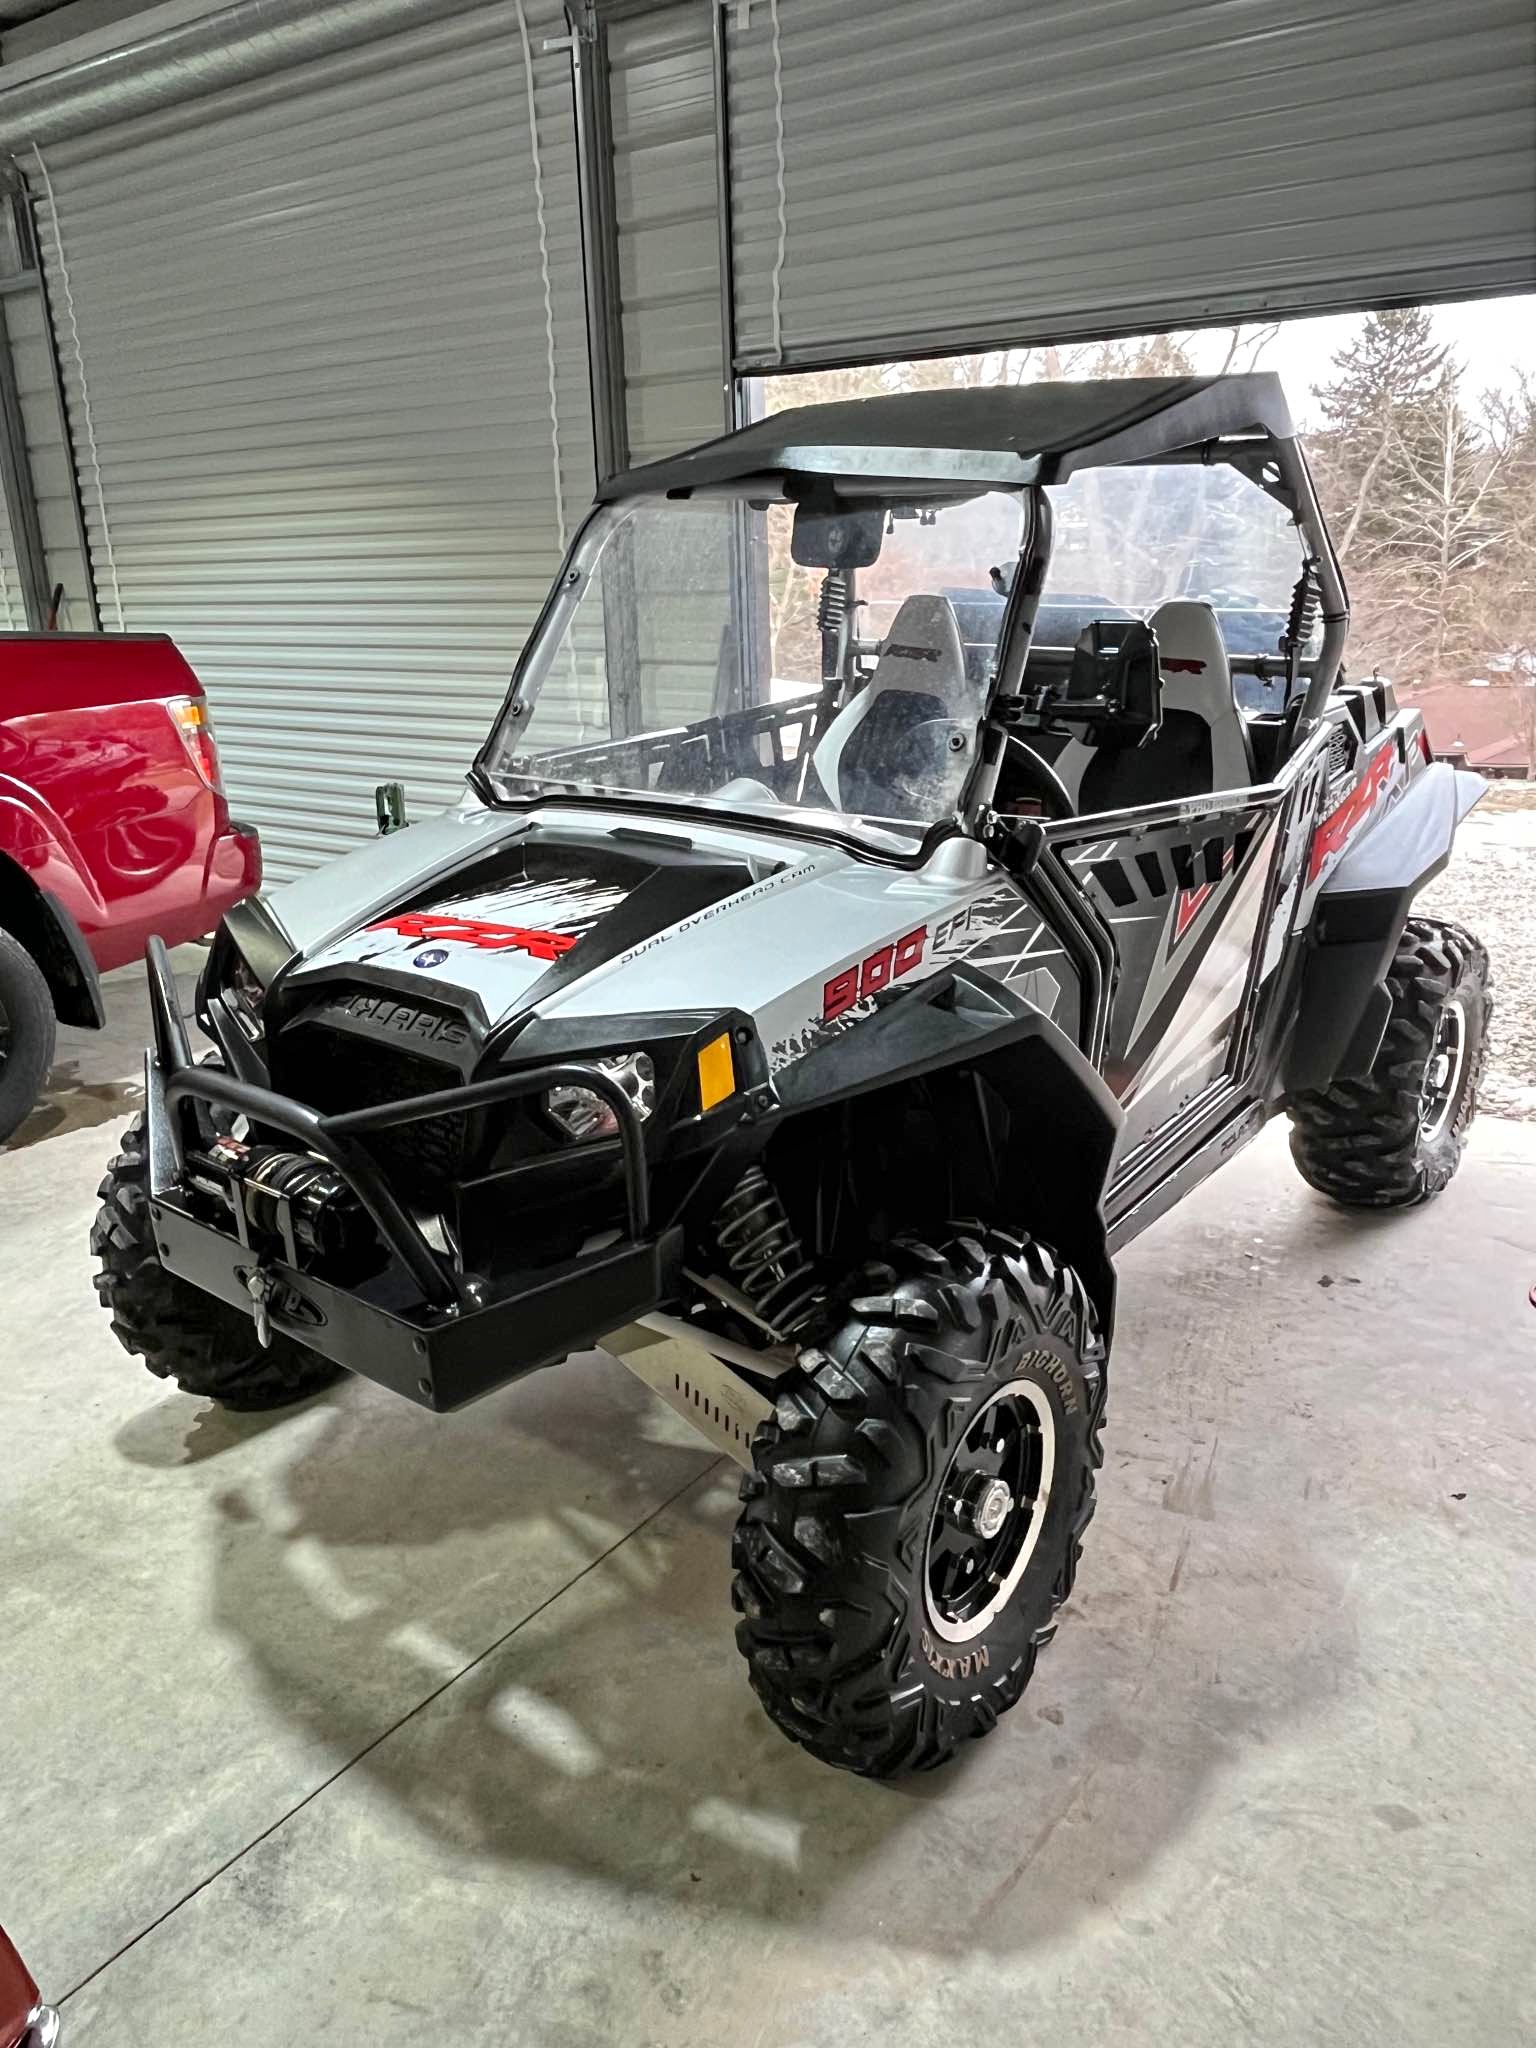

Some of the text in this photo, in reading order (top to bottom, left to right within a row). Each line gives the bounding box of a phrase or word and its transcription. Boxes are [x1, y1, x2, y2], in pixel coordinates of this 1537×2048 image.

[364, 912, 578, 961] RZR
[621, 863, 816, 965] DUAL OVERHEAD CAM
[823, 905, 972, 1023] 900 EFI
[334, 994, 469, 1046] OLARIS
[1013, 1349, 1079, 1416] BIGHORN
[920, 1627, 990, 1680] MAXXIS
